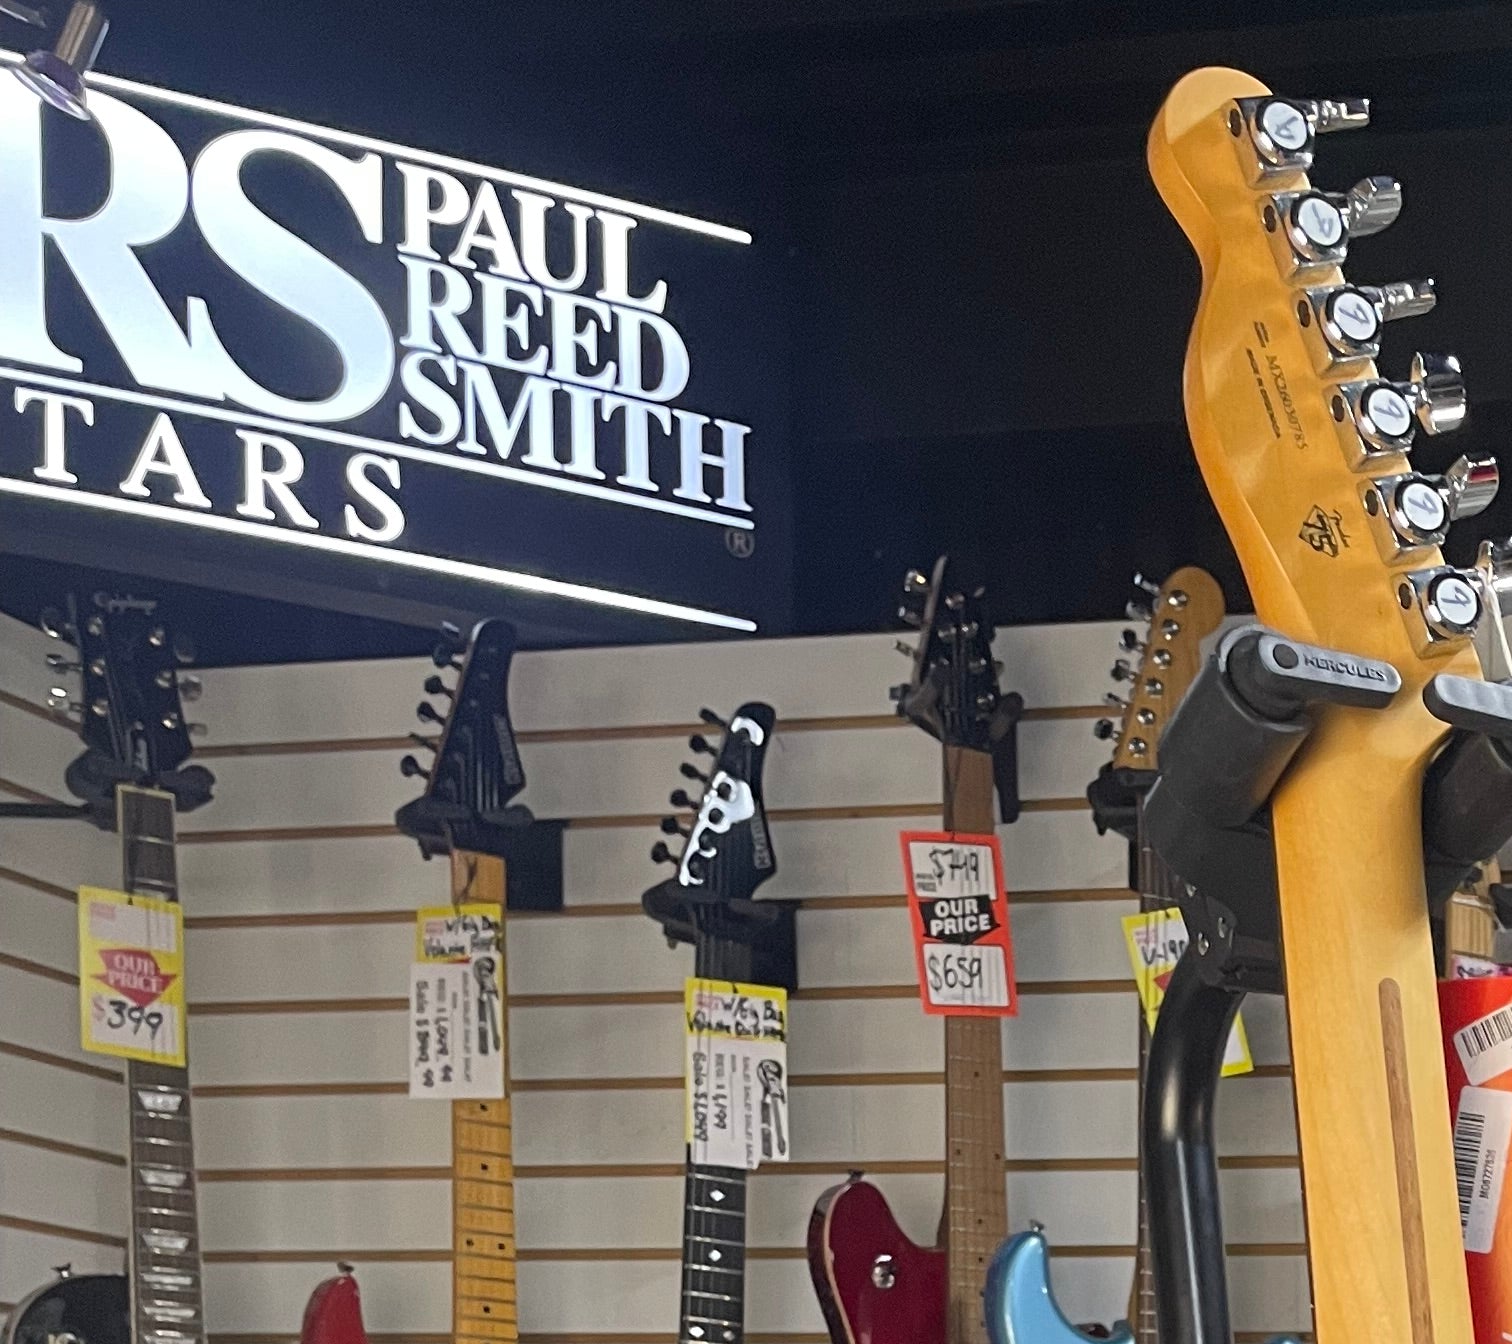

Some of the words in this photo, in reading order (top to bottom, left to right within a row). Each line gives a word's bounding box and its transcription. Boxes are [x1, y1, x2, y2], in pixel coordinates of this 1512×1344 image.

[396, 161, 667, 314] PAUL
[399, 253, 691, 403] REED
[399, 352, 754, 513] SMITH
[1304, 654, 1387, 683] HERCULES
[933, 898, 979, 919] OUR
[929, 914, 991, 937] PRICE
[114, 953, 156, 975] OUR
[927, 953, 984, 992] $659
[107, 970, 163, 994] PRICE
